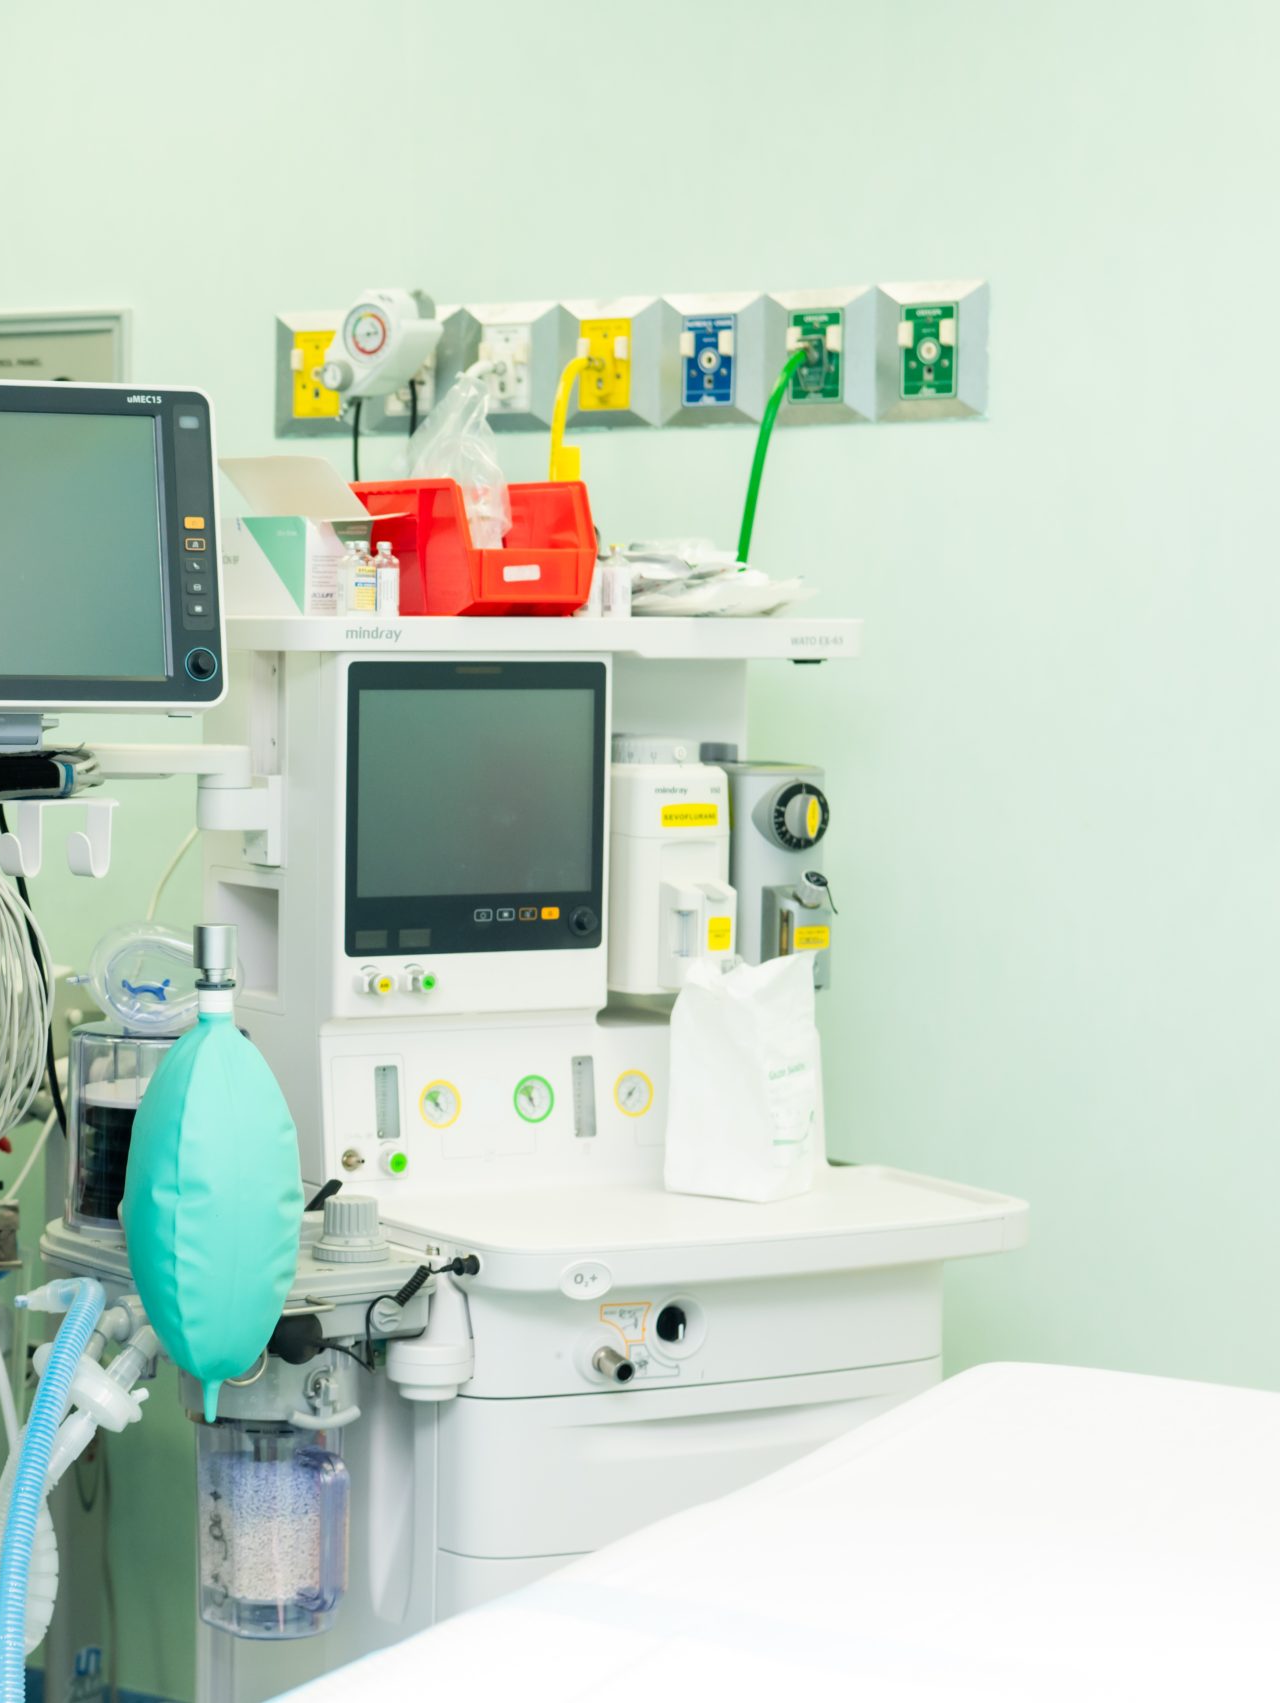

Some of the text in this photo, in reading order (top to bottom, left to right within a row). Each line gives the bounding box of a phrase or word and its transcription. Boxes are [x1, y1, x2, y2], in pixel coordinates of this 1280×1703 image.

[126, 394, 162, 404] uMEC15
[345, 626, 402, 643] mindray
[654, 785, 688, 796] mindray
